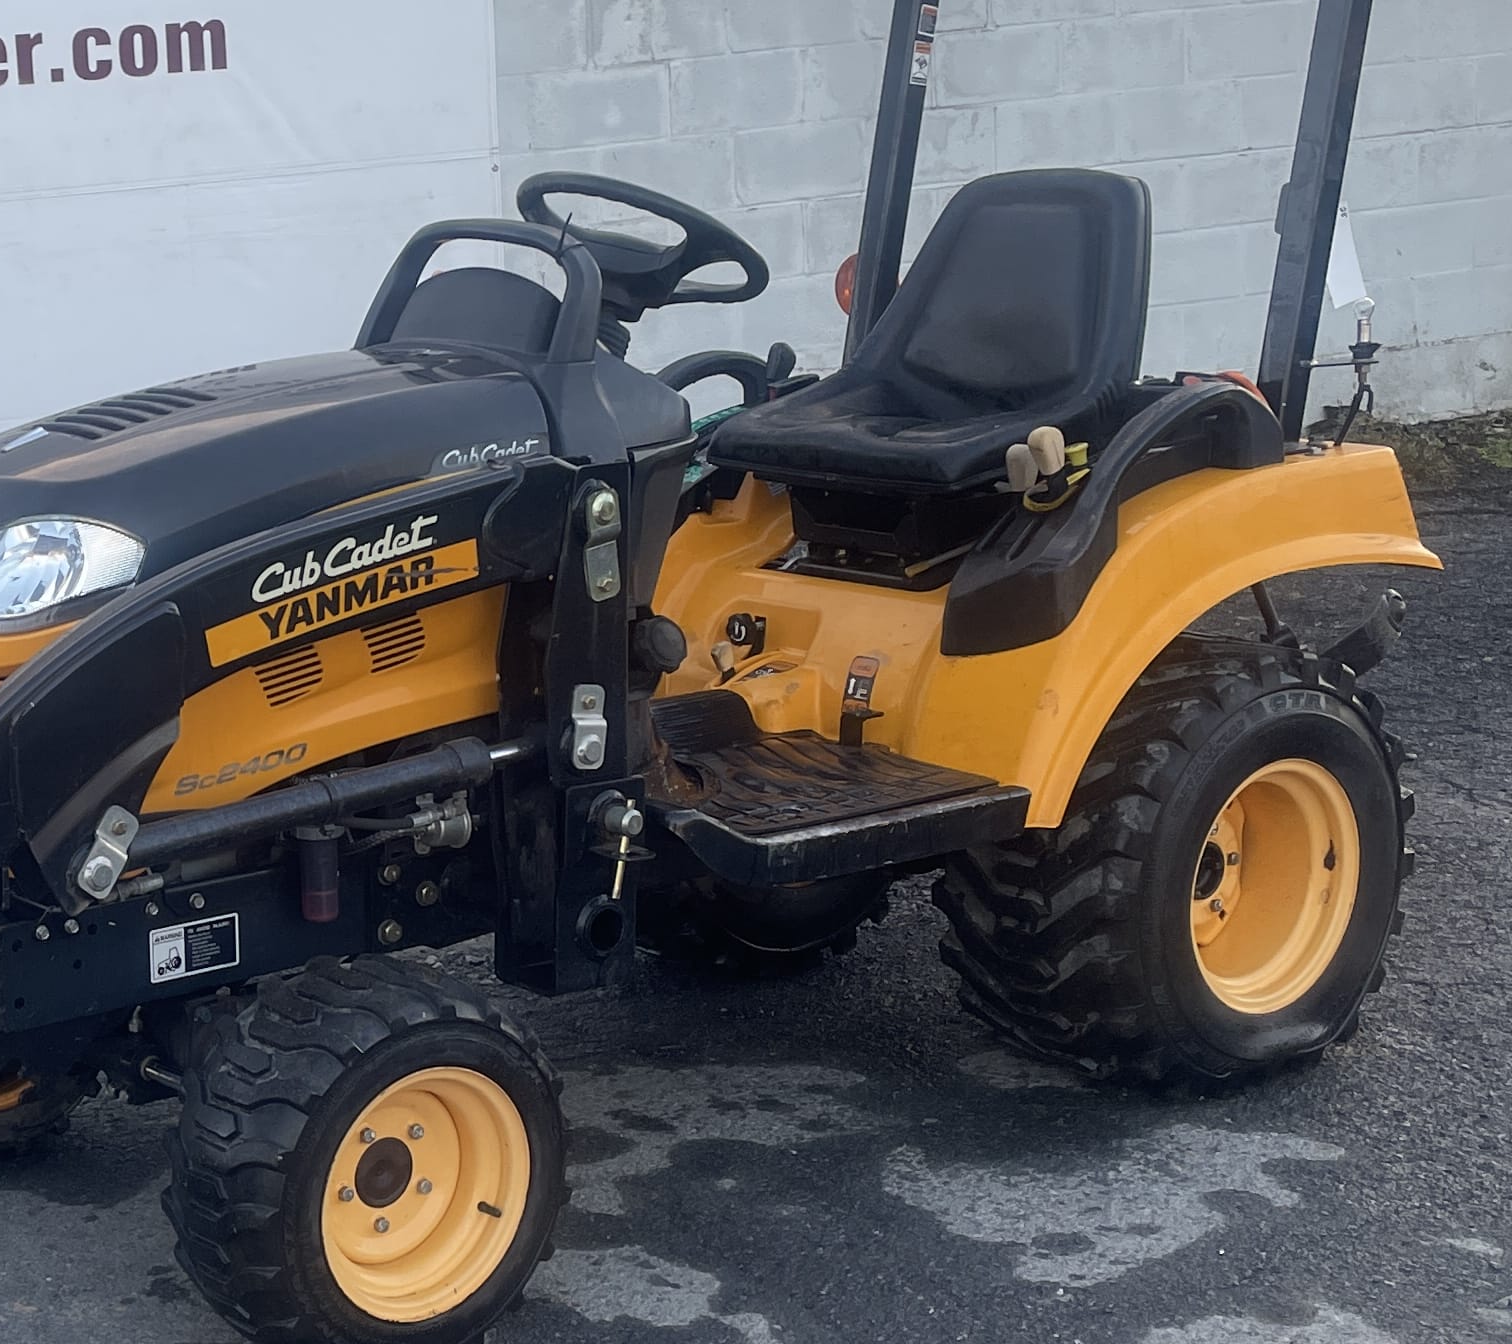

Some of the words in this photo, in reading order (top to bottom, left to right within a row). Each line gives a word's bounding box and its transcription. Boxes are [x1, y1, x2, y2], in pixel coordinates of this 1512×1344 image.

[251, 550, 321, 603] Cub
[323, 515, 438, 577] Cadet
[259, 556, 435, 640] YANMAR
